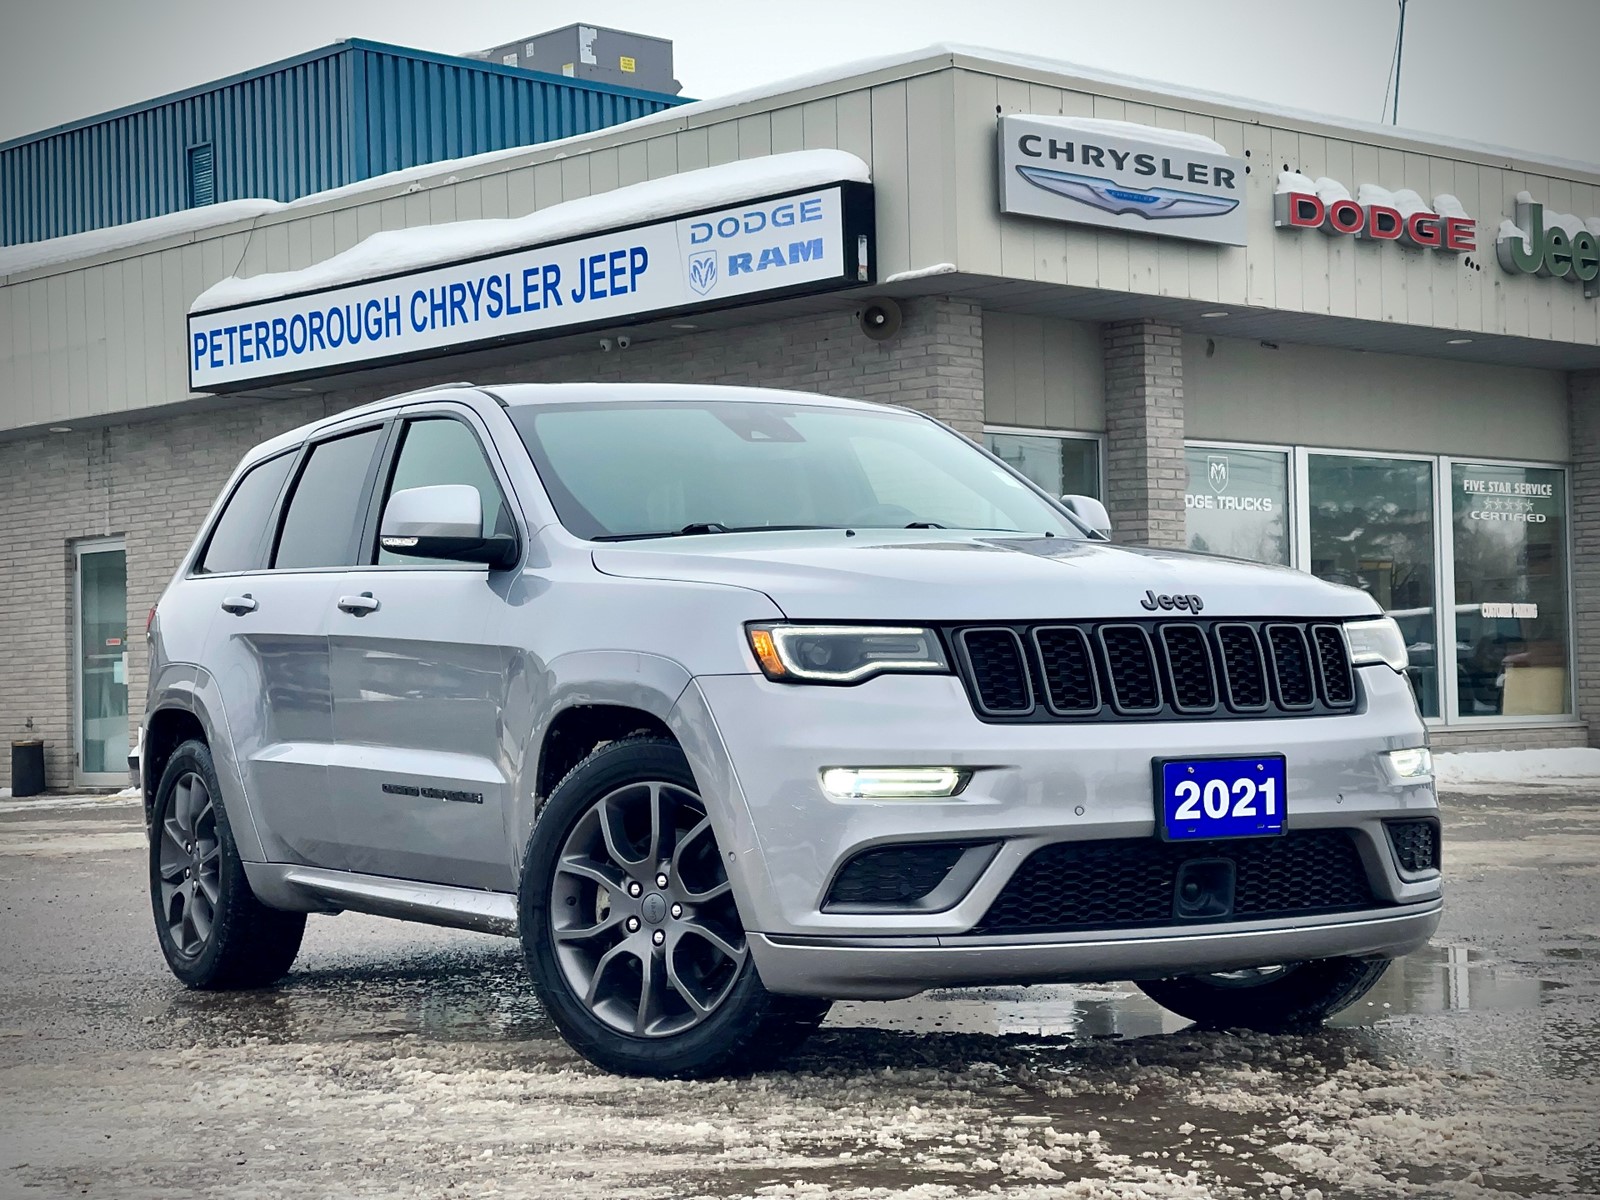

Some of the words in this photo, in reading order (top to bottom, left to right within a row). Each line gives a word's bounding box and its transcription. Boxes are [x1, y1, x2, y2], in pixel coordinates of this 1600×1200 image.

[1017, 134, 1236, 190] CHRYSLER
[690, 198, 824, 245] DODGE
[1290, 192, 1477, 252] DODGE
[1505, 203, 1600, 281] Jee
[727, 237, 824, 277] RAM
[193, 295, 402, 371] PETERBOROUGH
[410, 264, 562, 333] CHRYSLER
[571, 246, 649, 304] JEEP
[1184, 494, 1213, 509] DGE
[1217, 496, 1273, 512] TRUCKS
[1463, 480, 1486, 492] FIVE
[1488, 481, 1512, 494] STAR
[1514, 483, 1553, 496] SERVICE
[1471, 510, 1547, 523] CERTIFIED
[1140, 590, 1204, 615] Jeep
[1174, 777, 1276, 820] 2021
